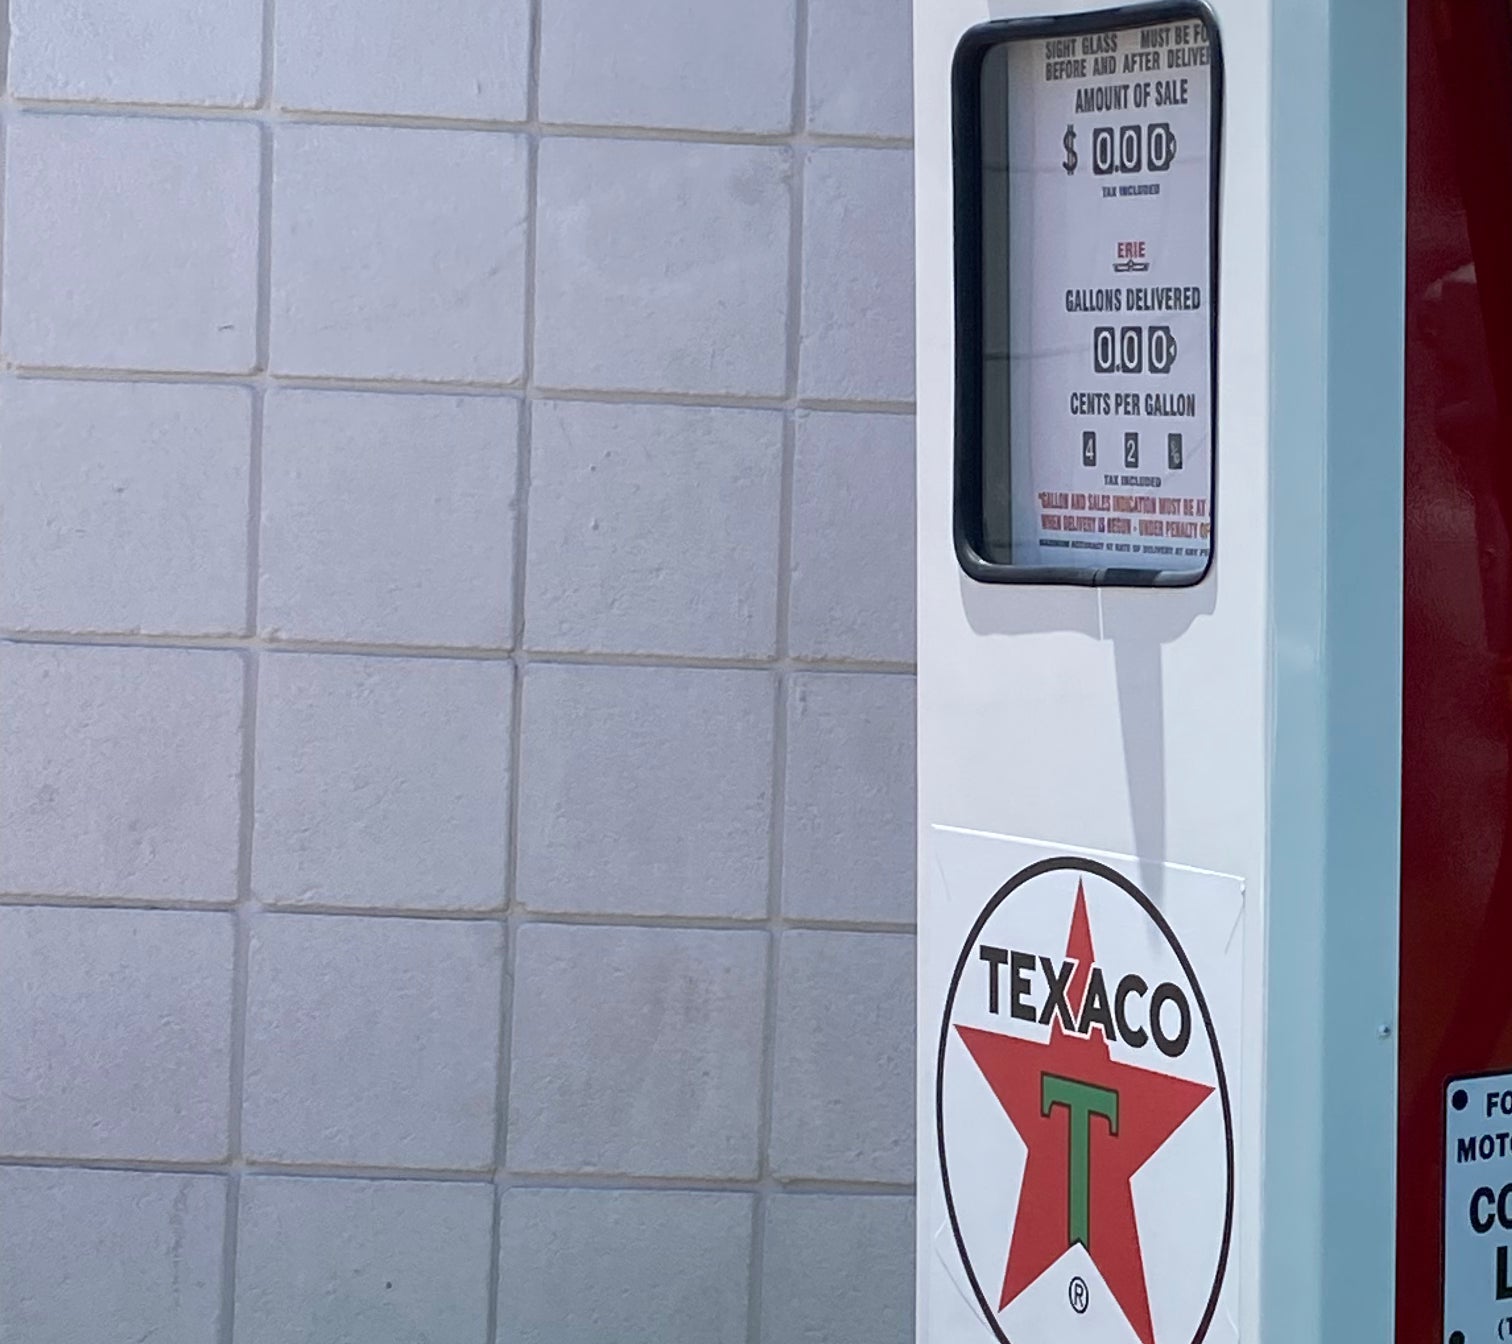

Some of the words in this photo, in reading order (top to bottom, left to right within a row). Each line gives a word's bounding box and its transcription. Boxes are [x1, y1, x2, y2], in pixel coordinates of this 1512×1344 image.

[1045, 38, 1077, 60] SIGHT
[1081, 32, 1117, 55] GLASS
[1140, 27, 1171, 48] MUST
[1174, 25, 1190, 45] BE
[1045, 58, 1086, 81] BEFORE
[1092, 55, 1116, 76] AND
[1122, 50, 1160, 73] AFTER
[1075, 84, 1130, 114] AMOUNT
[1133, 82, 1151, 108] OF
[1154, 78, 1188, 107] SALE
[1062, 123, 1079, 176] $
[1102, 186, 1117, 198] TAX
[1118, 183, 1160, 197] INCLUDED
[1117, 241, 1146, 259] ERIE
[1065, 288, 1122, 312] GALLONS
[1126, 286, 1201, 311] DELIVERED
[1070, 392, 1111, 416] CENTS
[1114, 393, 1141, 416] PER
[1144, 393, 1195, 417] GALLON
[1104, 474, 1119, 486] TAX
[1120, 475, 1162, 488] INCLUDED
[1088, 493, 1111, 512] SALES
[979, 945, 1191, 1058] TEXACO
